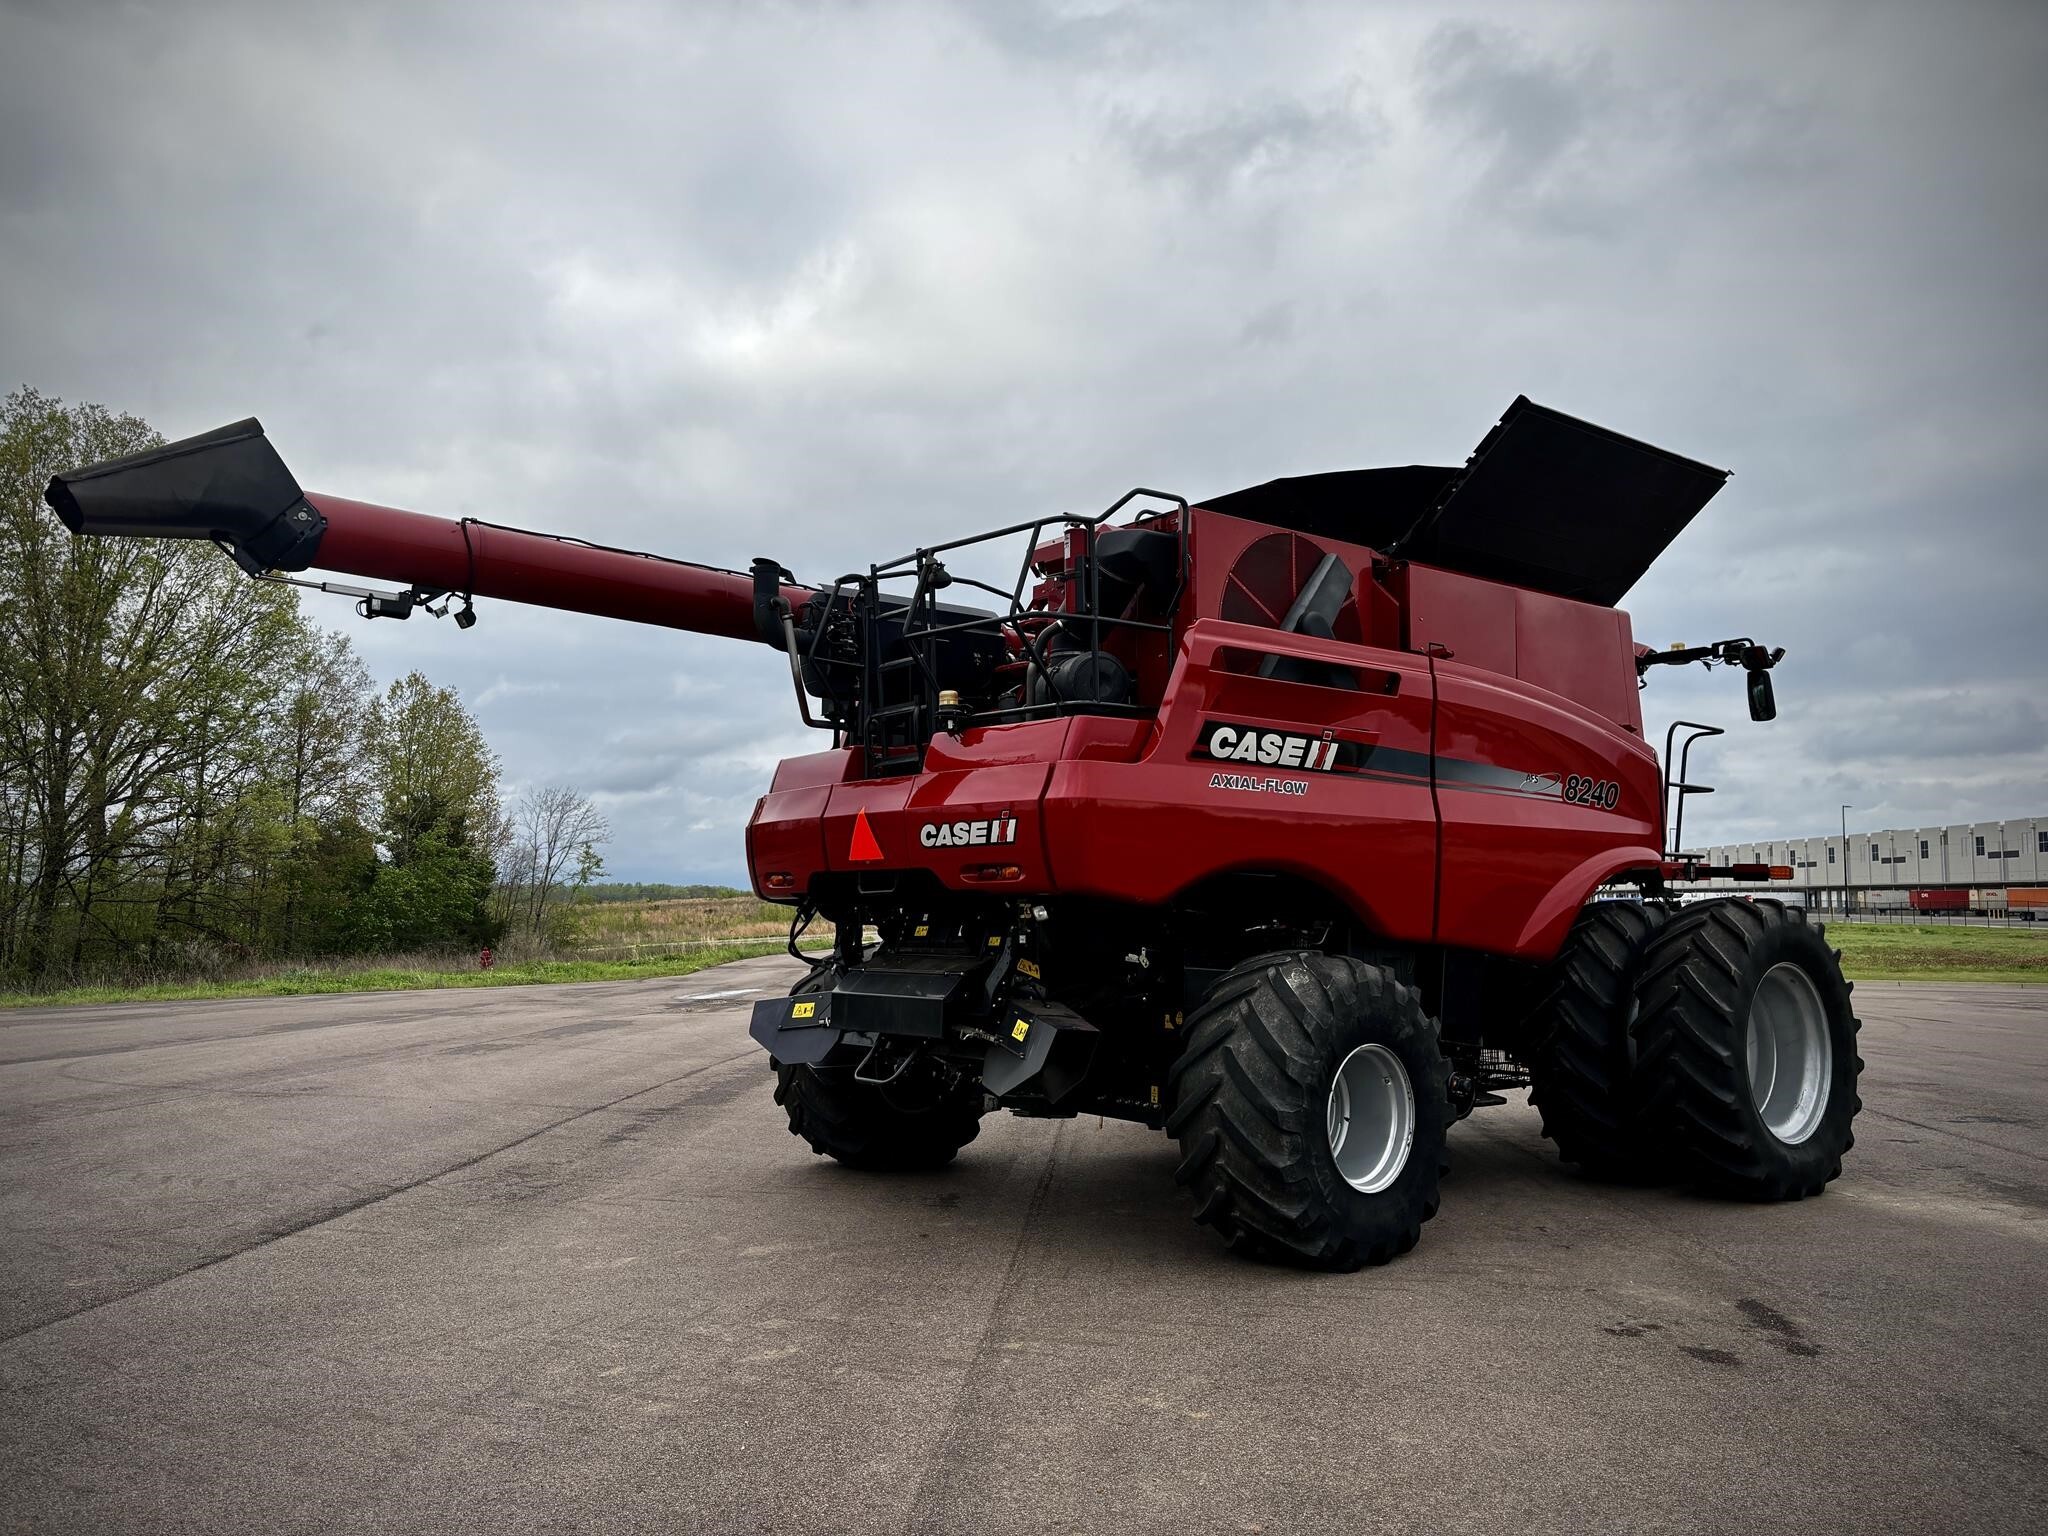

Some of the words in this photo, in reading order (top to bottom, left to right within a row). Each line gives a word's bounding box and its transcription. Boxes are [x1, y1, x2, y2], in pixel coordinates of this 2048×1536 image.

[1210, 727, 1306, 767] CASE
[1209, 773, 1308, 795] AXIAL-FLOW
[1564, 774, 1620, 810] 8240
[920, 821, 988, 847] CASE
